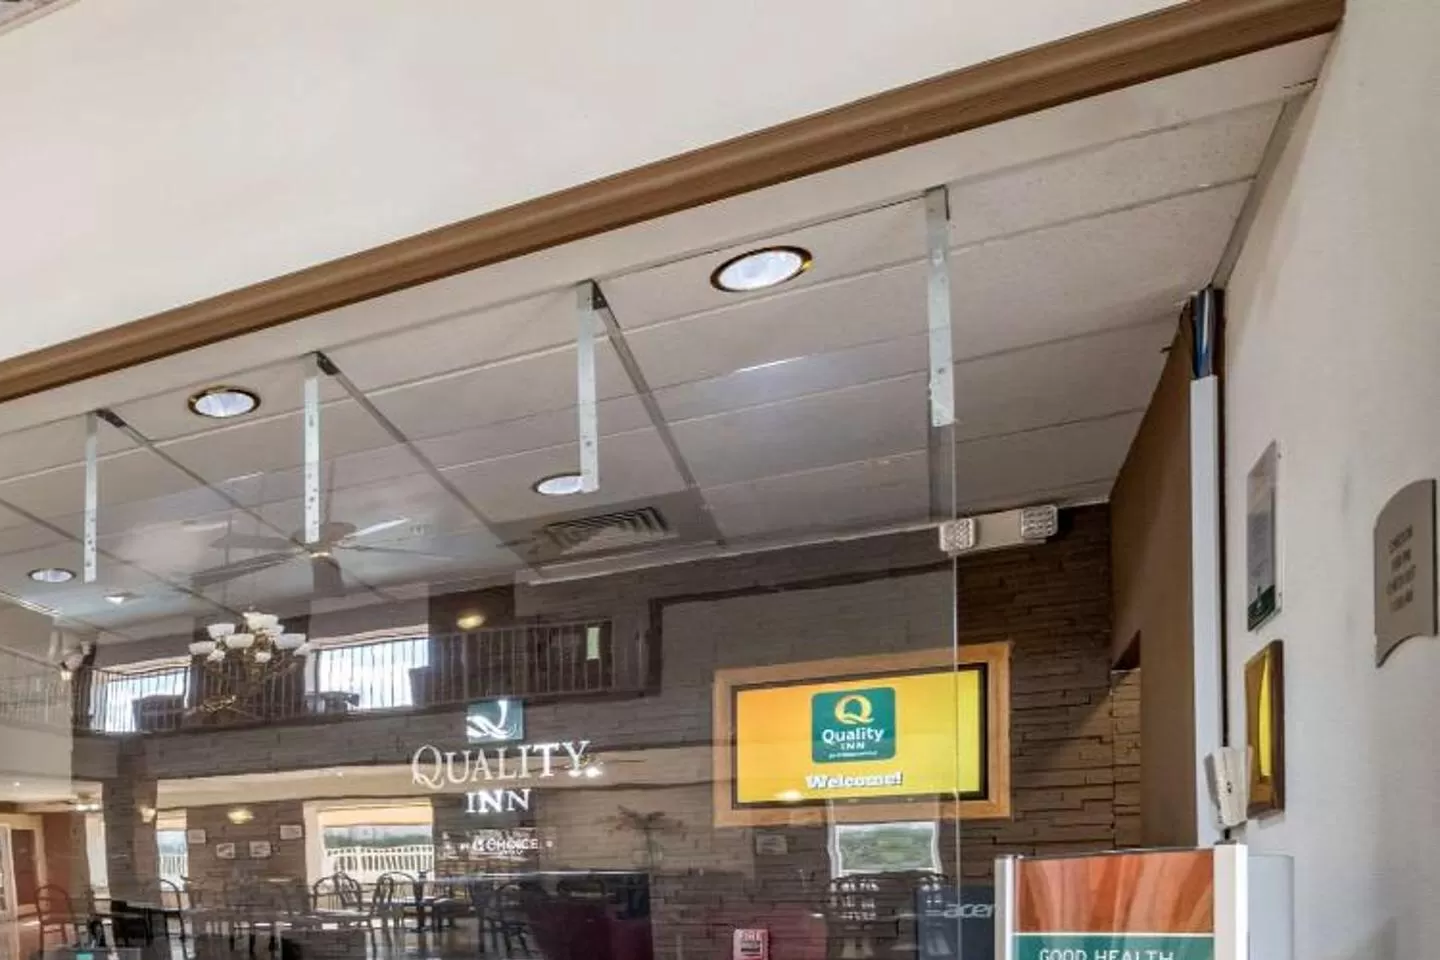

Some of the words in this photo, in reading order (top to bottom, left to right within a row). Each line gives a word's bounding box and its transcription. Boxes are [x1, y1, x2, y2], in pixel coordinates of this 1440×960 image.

[822, 727, 885, 745] Quality
[411, 740, 591, 790] QUALITY
[465, 788, 531, 814] INN
